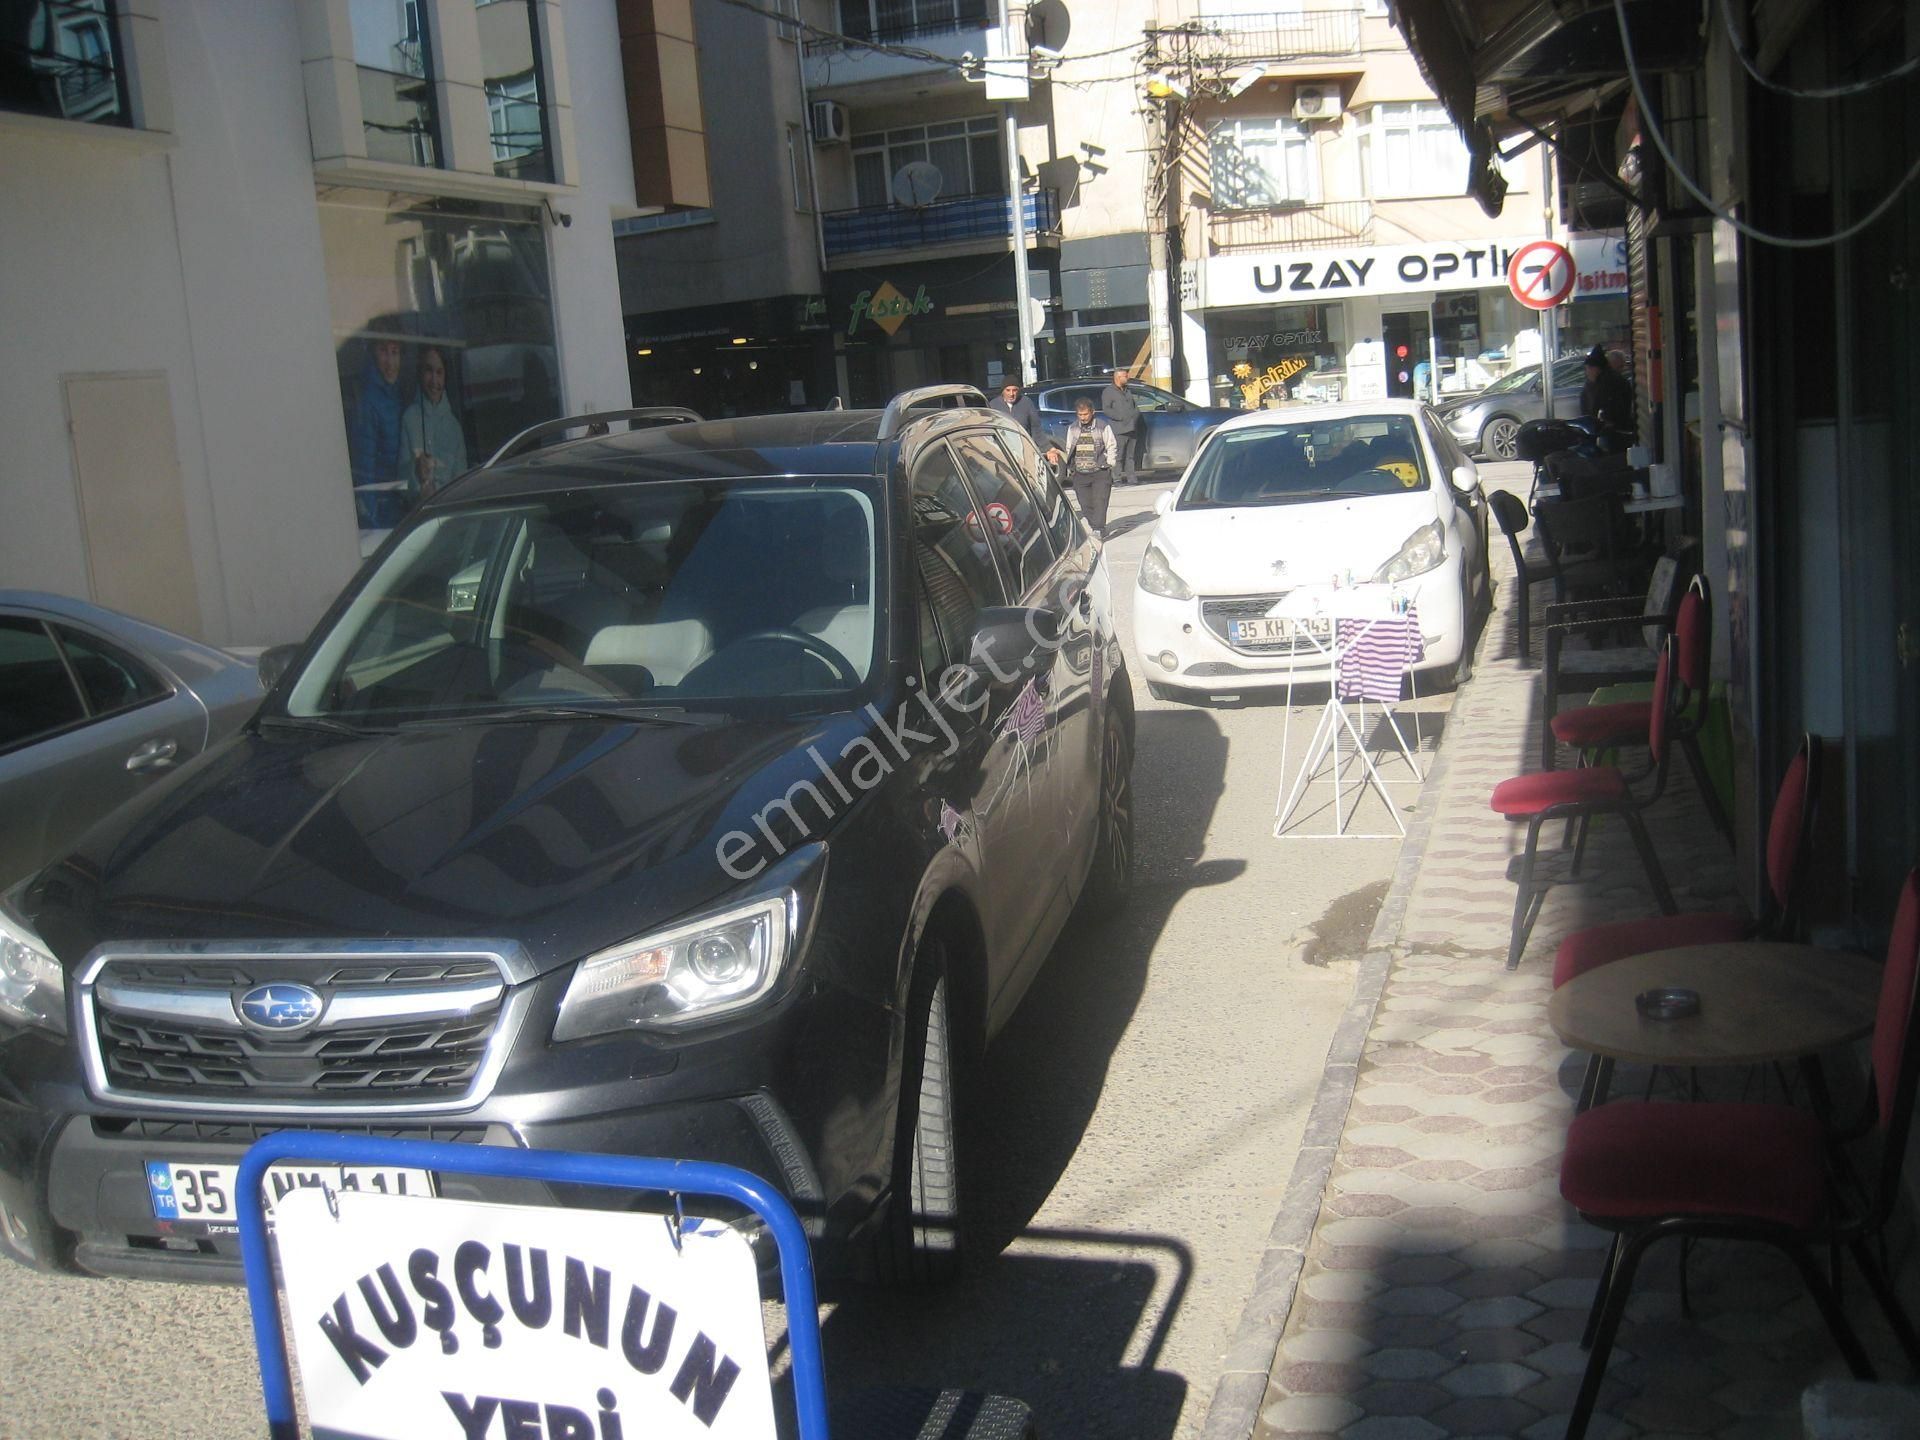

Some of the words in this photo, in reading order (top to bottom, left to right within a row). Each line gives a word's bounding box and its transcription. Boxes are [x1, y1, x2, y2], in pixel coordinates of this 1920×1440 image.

[1253, 258, 1375, 293] UZAY
[1224, 334, 1270, 350] UZAY
[1273, 328, 1321, 346] OPTİK
[1239, 622, 1257, 638] 35
[1266, 620, 1285, 637] KH
[175, 1169, 228, 1214] 35
[318, 1240, 741, 1428] KUŞÇUNUN
